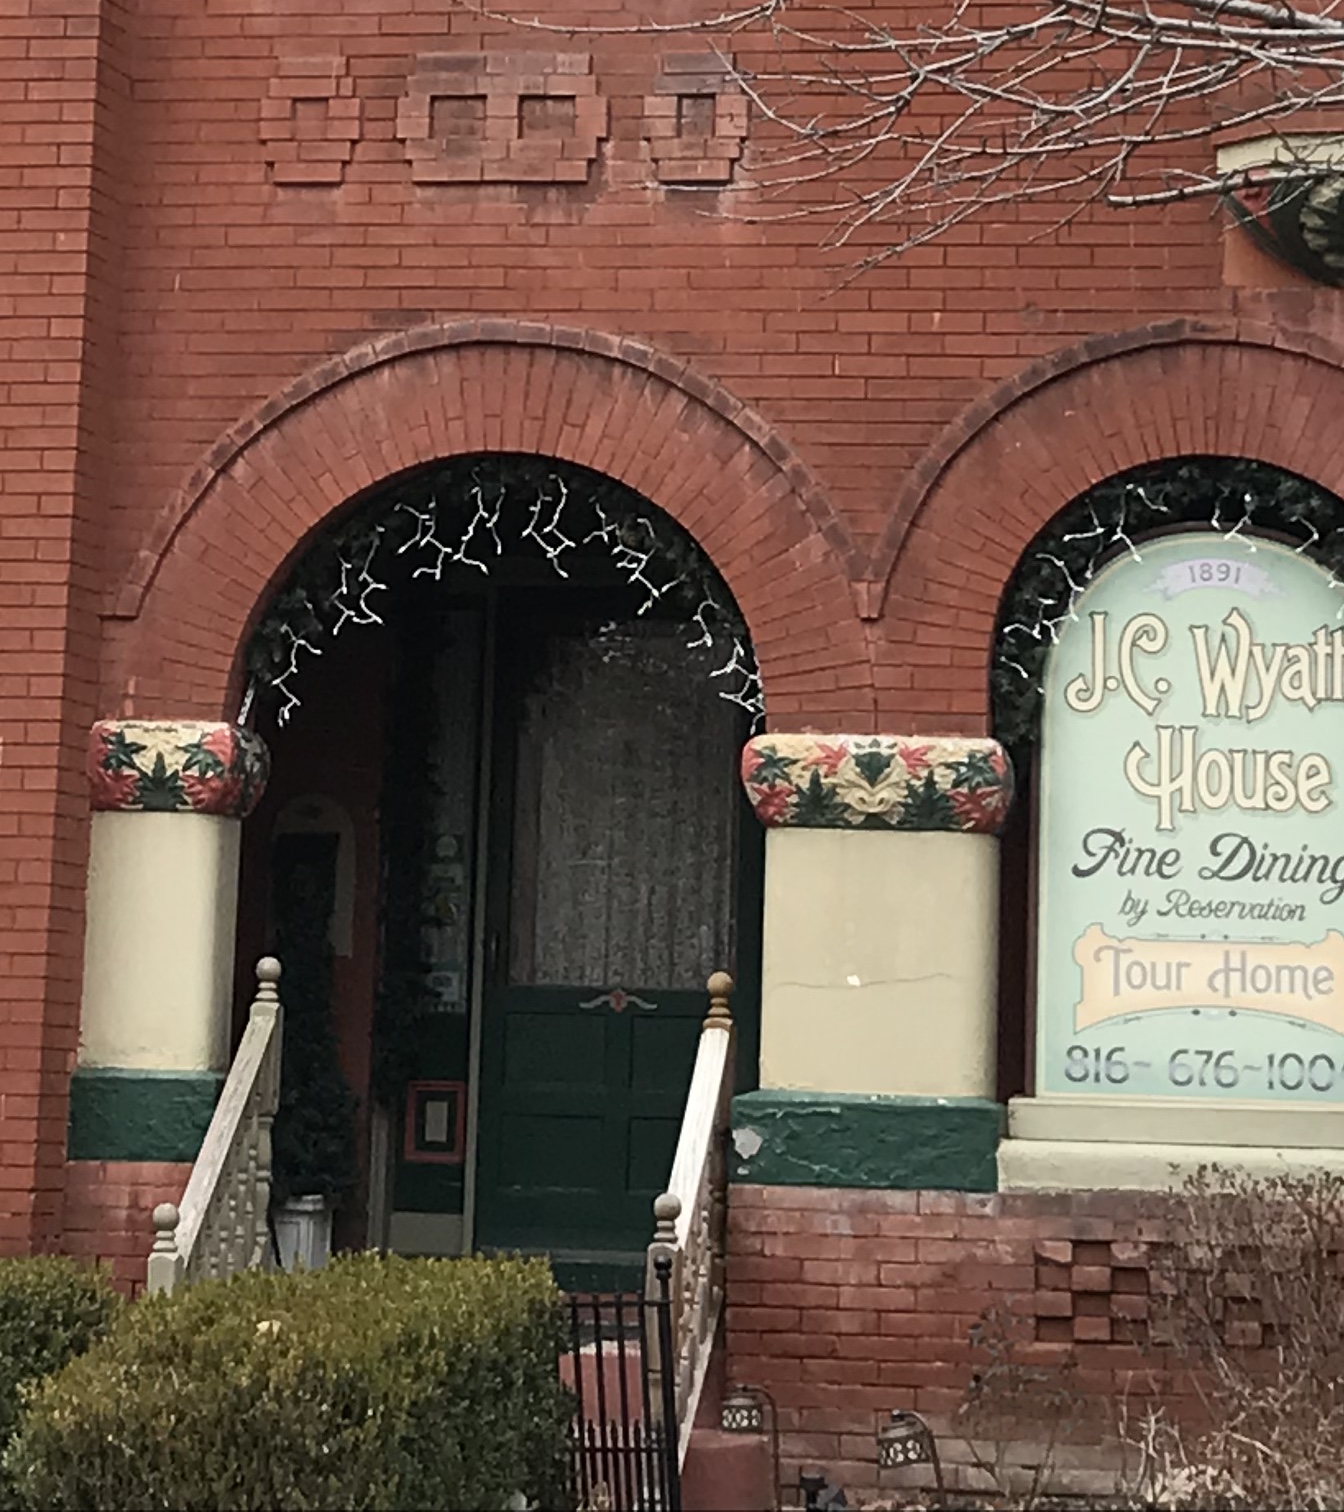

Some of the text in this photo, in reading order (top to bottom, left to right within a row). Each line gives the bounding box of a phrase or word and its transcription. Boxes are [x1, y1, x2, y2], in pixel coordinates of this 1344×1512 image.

[1188, 563, 1242, 585] 1891
[1064, 610, 1172, 716] J.C.
[1124, 725, 1332, 831] House
[1071, 827, 1182, 880] Fine
[1118, 888, 1307, 927] by Reservation
[1093, 944, 1335, 1000] Tour Home
